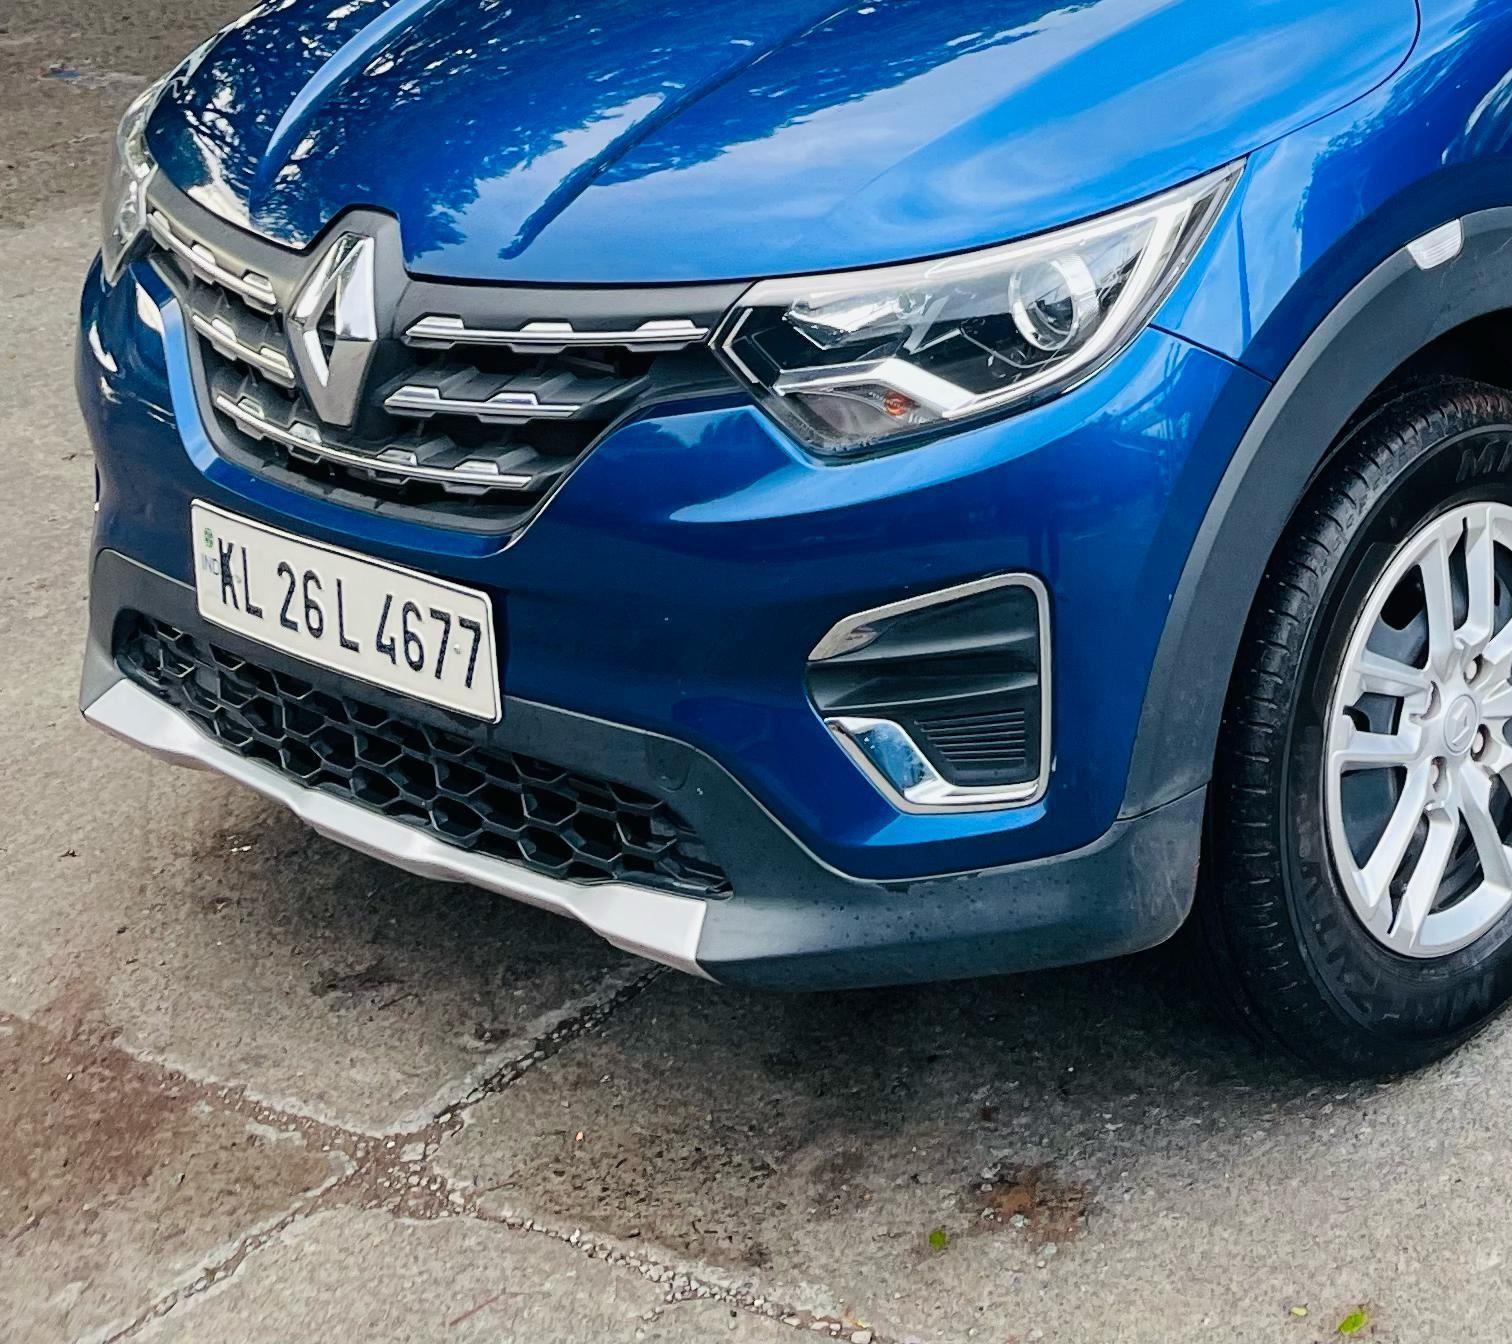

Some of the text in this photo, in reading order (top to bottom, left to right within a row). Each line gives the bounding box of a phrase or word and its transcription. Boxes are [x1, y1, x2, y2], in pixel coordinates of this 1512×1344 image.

[217, 538, 481, 689] KL 26 L 4677
